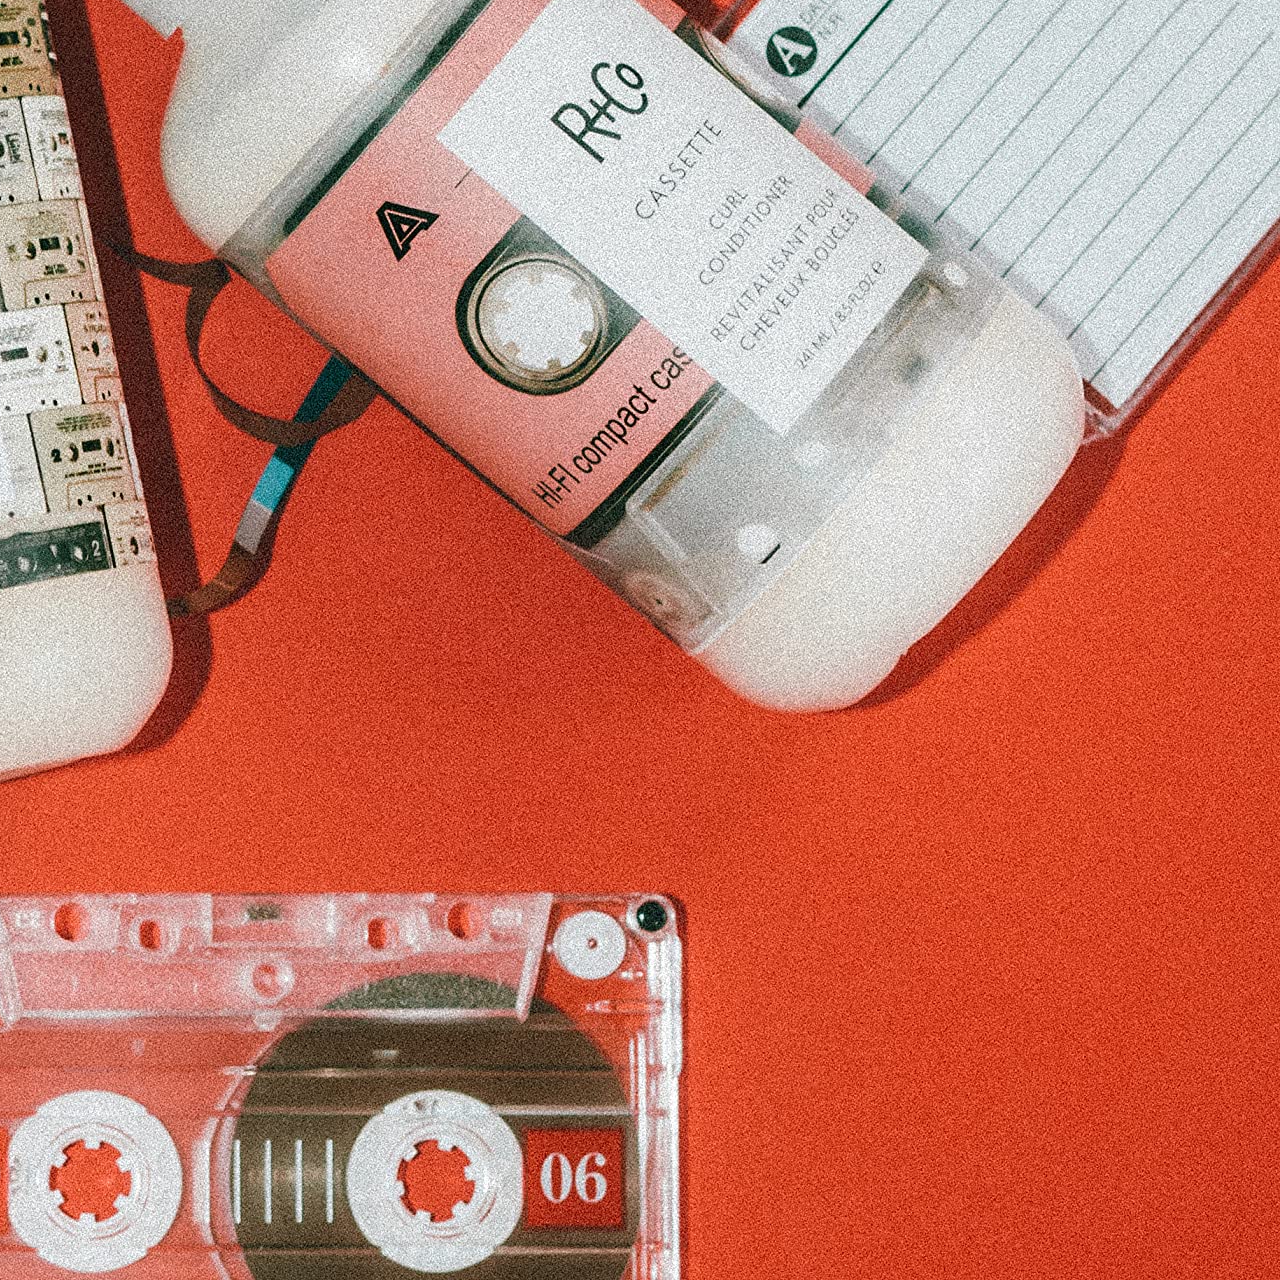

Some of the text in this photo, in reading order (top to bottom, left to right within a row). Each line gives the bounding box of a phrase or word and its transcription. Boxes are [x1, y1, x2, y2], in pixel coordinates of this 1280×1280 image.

[771, 32, 814, 75] A
[550, 61, 649, 164] R+Co
[635, 119, 722, 220] CASSETTE
[709, 188, 749, 230] CURL
[375, 201, 440, 262] A
[699, 174, 793, 285] CONDITIONER
[709, 187, 838, 343] REVITALISANT POUR
[739, 207, 860, 351] CHEVEUX BOUCLÉS
[531, 346, 694, 509] HI-FI compact cas
[539, 1151, 609, 1204] 90
